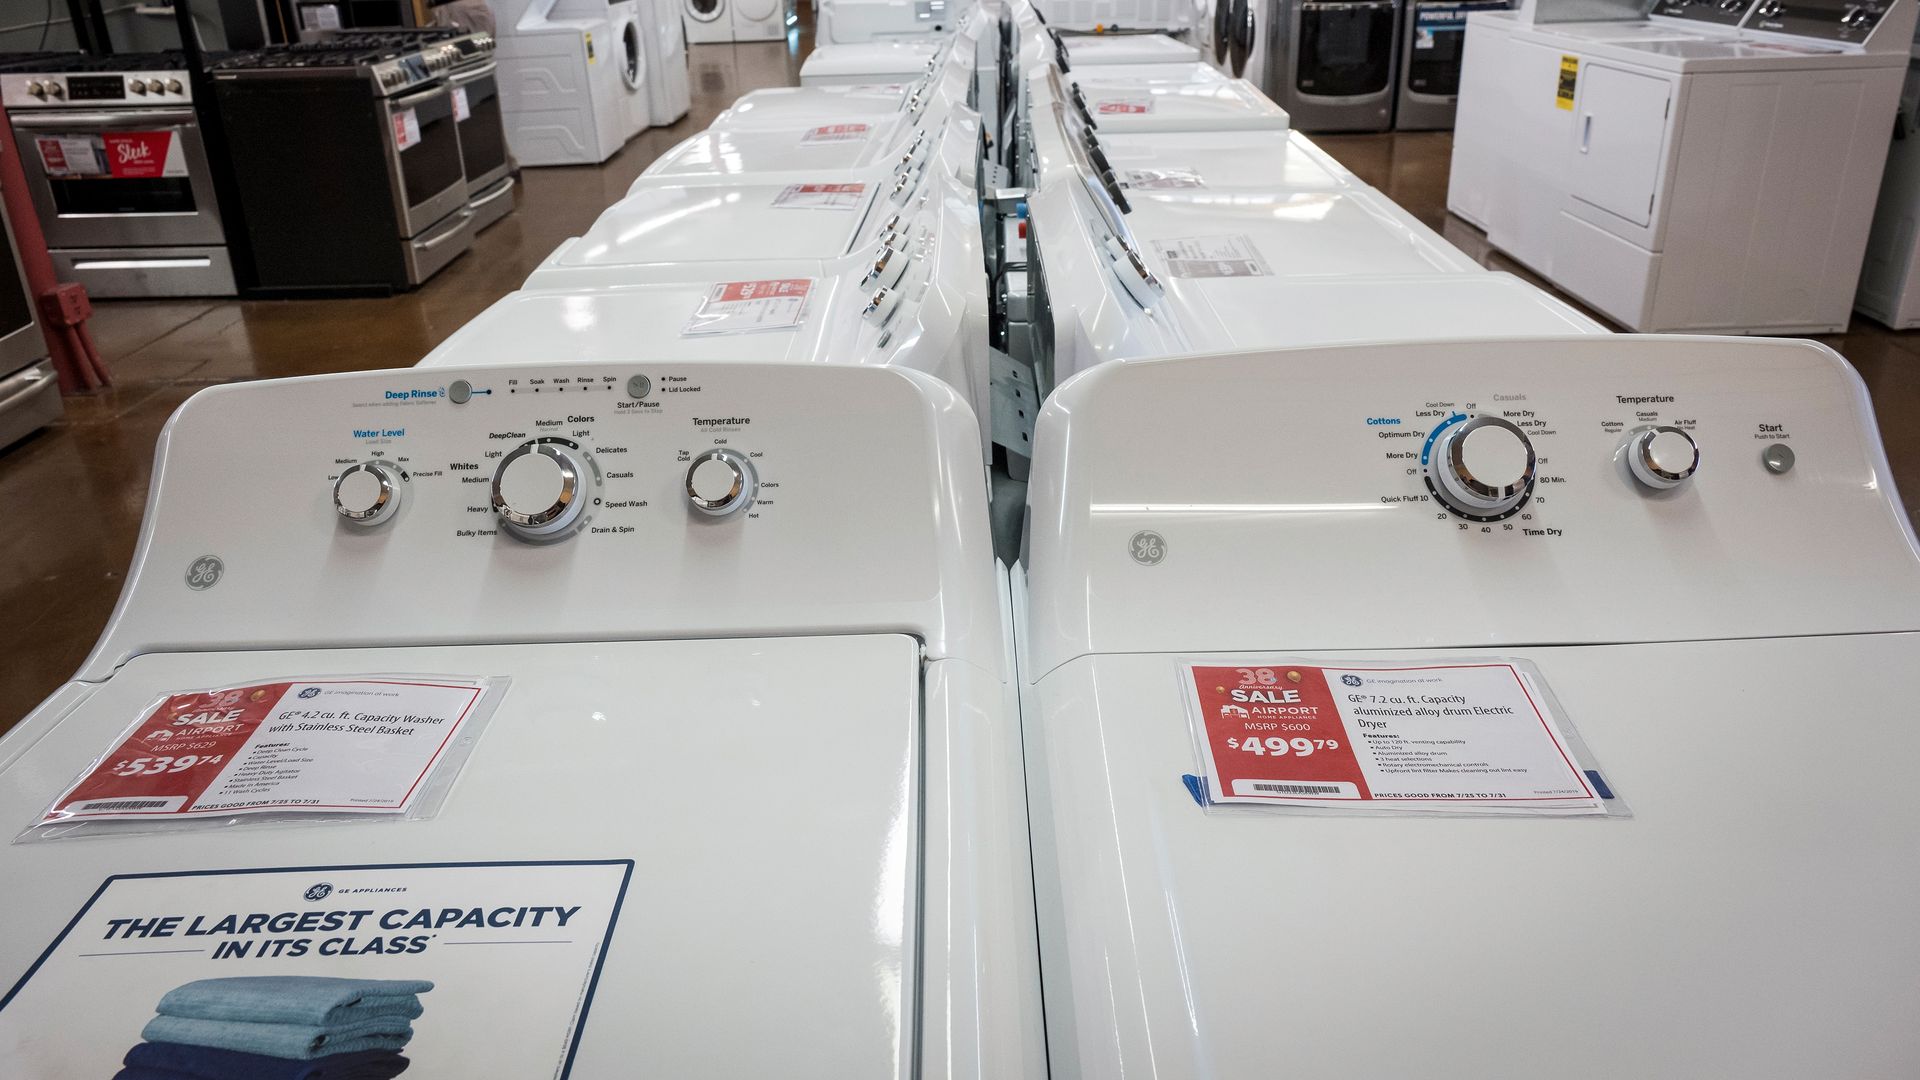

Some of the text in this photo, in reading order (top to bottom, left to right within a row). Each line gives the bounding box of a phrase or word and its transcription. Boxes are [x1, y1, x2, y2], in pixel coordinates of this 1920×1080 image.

[385, 389, 438, 400] Deep Rinse
[1493, 393, 1527, 402] Casuals
[1616, 395, 1674, 405] Temperature
[617, 401, 660, 409] Start/Pause
[1415, 409, 1446, 418] Less Dry
[1522, 410, 1535, 418] Dry
[567, 415, 595, 423] Colors
[692, 417, 751, 427] Temperature
[1366, 417, 1401, 426] Cottons
[1533, 420, 1547, 428] Dry
[1759, 423, 1783, 432] Start
[353, 429, 405, 438] Water Level
[488, 432, 526, 440] DeepClean
[572, 430, 590, 438] Light
[1378, 430, 1426, 440] Optimum Dry
[484, 451, 502, 459] Light
[1405, 452, 1419, 461] Dry
[450, 463, 479, 471] Whites
[606, 471, 634, 479] Casuals
[1381, 495, 1401, 504] Quick
[467, 506, 489, 514] Heavy
[1521, 513, 1532, 521] 60
[619, 526, 635, 534] Spin
[1503, 523, 1513, 531] 50
[456, 529, 476, 538] Bulky
[1522, 528, 1563, 538] Time Dry
[1236, 668, 1275, 685] 38
[1231, 689, 1302, 704] SALE
[1370, 695, 1388, 704] 7.2
[1390, 696, 1403, 704] cu.
[1406, 695, 1420, 704] ft.
[1421, 694, 1466, 705] Capacity
[1251, 706, 1318, 715] AIRPORT
[1353, 705, 1514, 718] aluminized alloy drum Electric
[172, 708, 245, 726] SALE
[301, 710, 320, 719] 4.2
[338, 711, 350, 720] ft.
[354, 712, 401, 724] Capacity
[402, 715, 445, 725] Washer
[1244, 722, 1311, 731] MSRP $600
[1358, 718, 1387, 730] Dryer
[176, 723, 244, 736] AIRPORT
[268, 722, 415, 736] with Stainless Steel Basket
[151, 740, 217, 752] MSRP $629
[246, 800, 271, 808] FROM
[103, 906, 582, 940] THE LARGEST CAPACITY
[211, 941, 253, 960] IN
[255, 938, 312, 958] ITS
